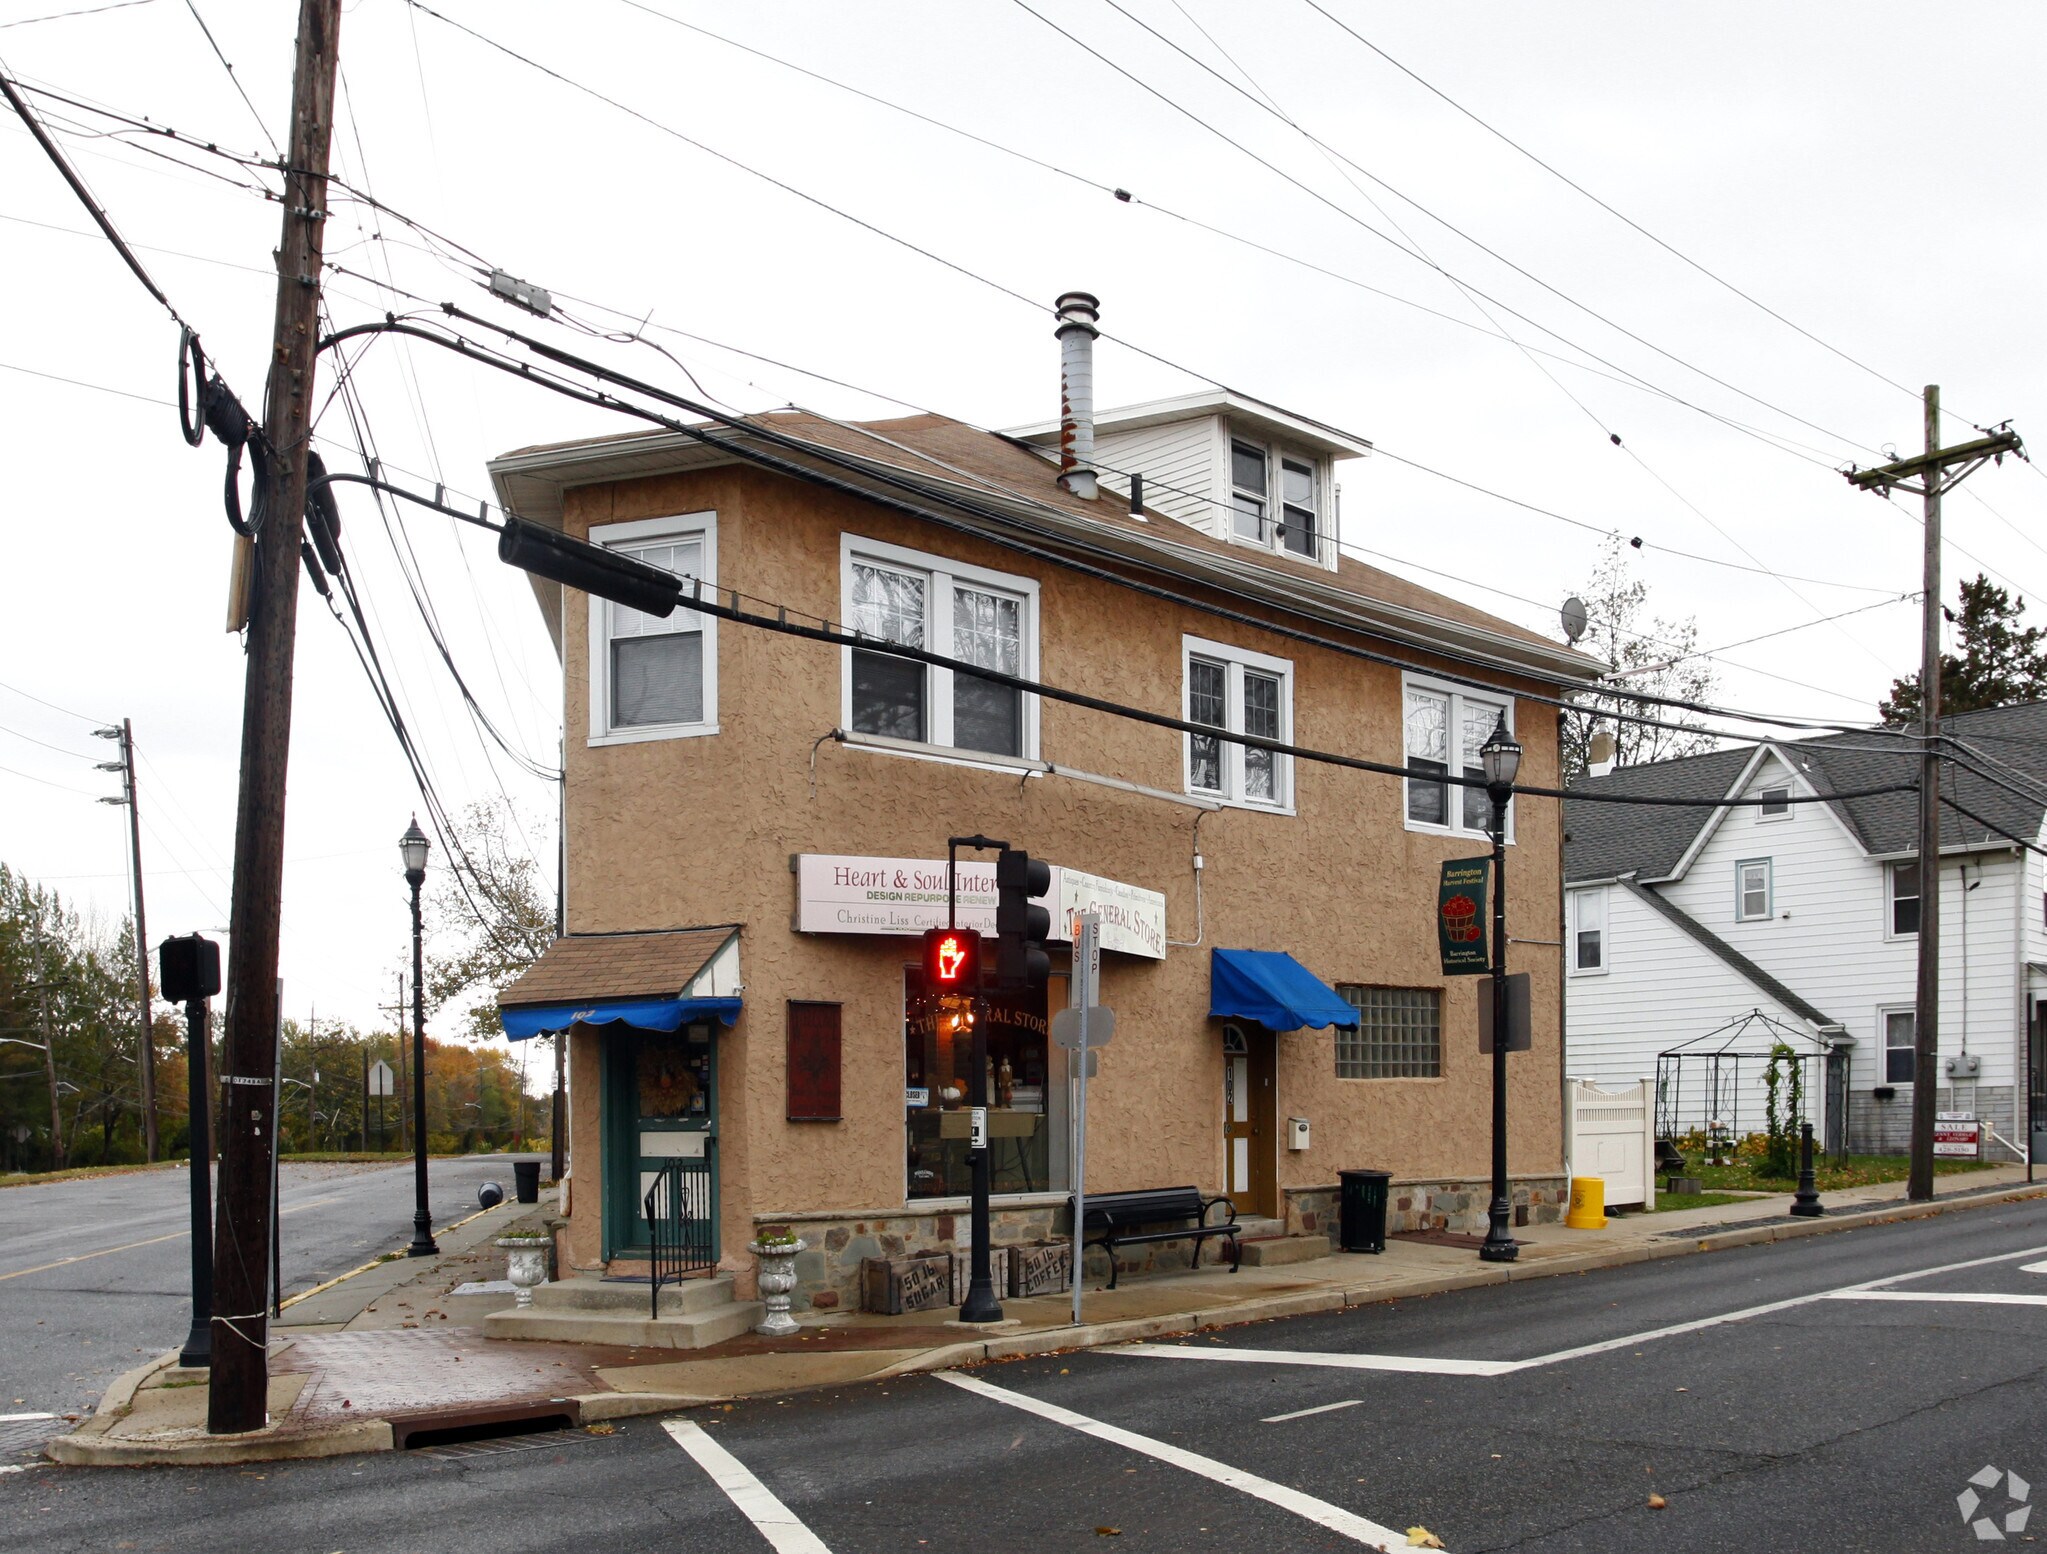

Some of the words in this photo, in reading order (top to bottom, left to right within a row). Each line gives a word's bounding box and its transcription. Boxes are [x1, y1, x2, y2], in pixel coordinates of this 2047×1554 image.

[833, 866, 887, 888] Heart
[893, 869, 909, 889] &
[914, 862, 950, 890] Soul
[955, 872, 998, 893] Inter
[1446, 868, 1482, 878] Barrington
[866, 890, 903, 901] DESIGN
[904, 892, 962, 904] REPURPOE
[963, 895, 997, 905] RENEW
[837, 909, 887, 925] Christine
[890, 911, 909, 926] Liss
[1133, 910, 1162, 956] STORE
[570, 1009, 596, 1020] 102
[1014, 1010, 1048, 1036] STOR
[1026, 1254, 1067, 1292] COFFEE
[905, 1274, 945, 1309] SUGAR
